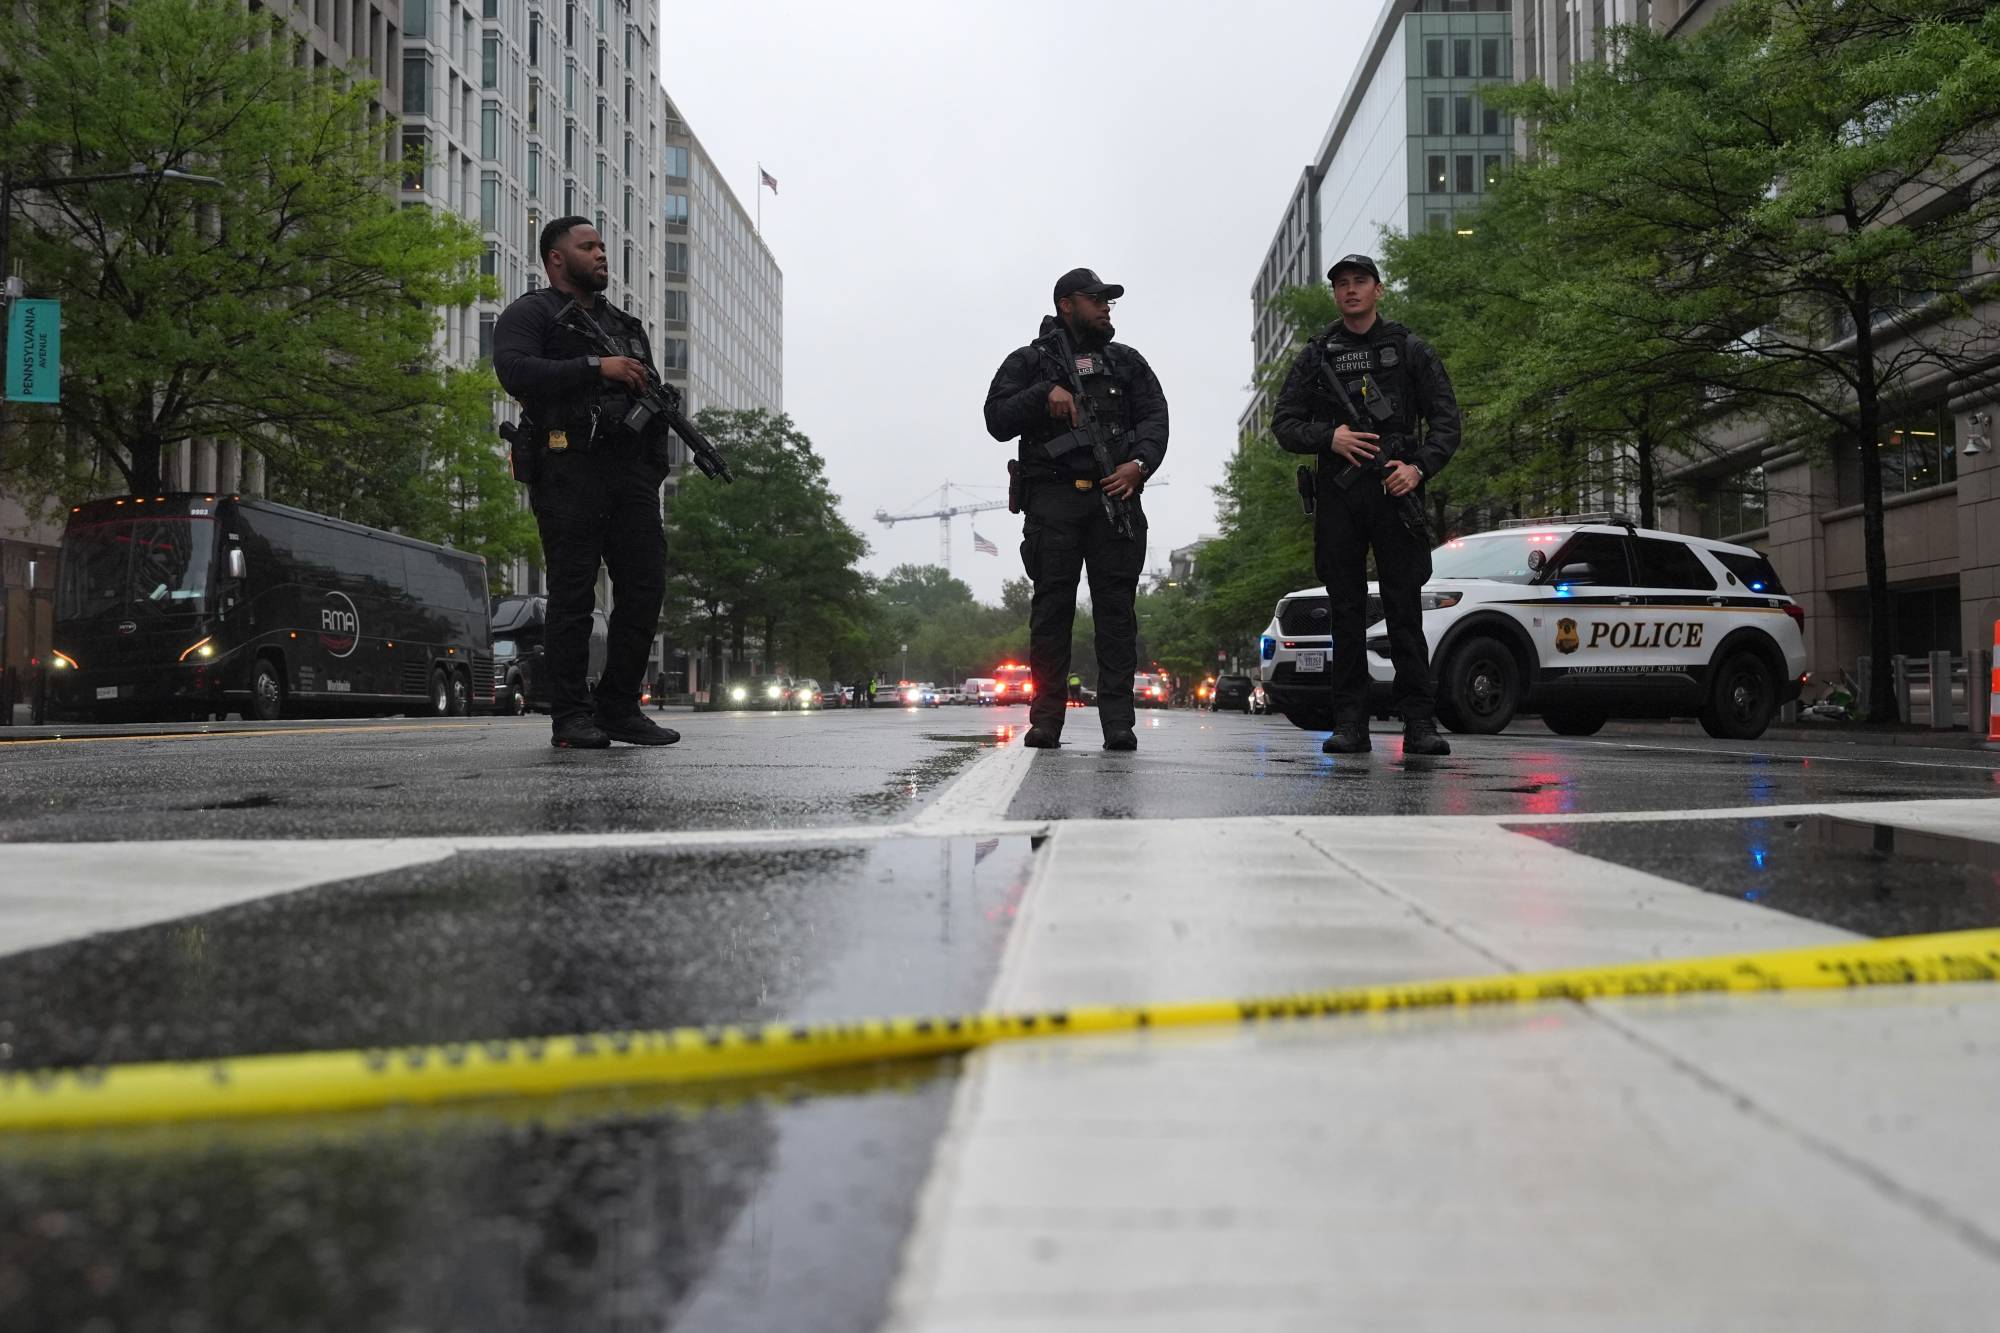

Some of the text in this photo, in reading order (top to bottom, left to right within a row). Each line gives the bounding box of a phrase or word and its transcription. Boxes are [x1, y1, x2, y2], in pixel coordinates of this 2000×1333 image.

[23, 306, 36, 395] PENNSYLVANIA
[39, 332, 48, 368] AVENUE
[1336, 351, 1369, 362] SECRET
[1335, 361, 1372, 372] SERVICE
[321, 609, 355, 632] RMA
[1586, 621, 1704, 648] POLICE
[1568, 666, 1597, 674] UNITED
[1626, 665, 1655, 673] SECRET
